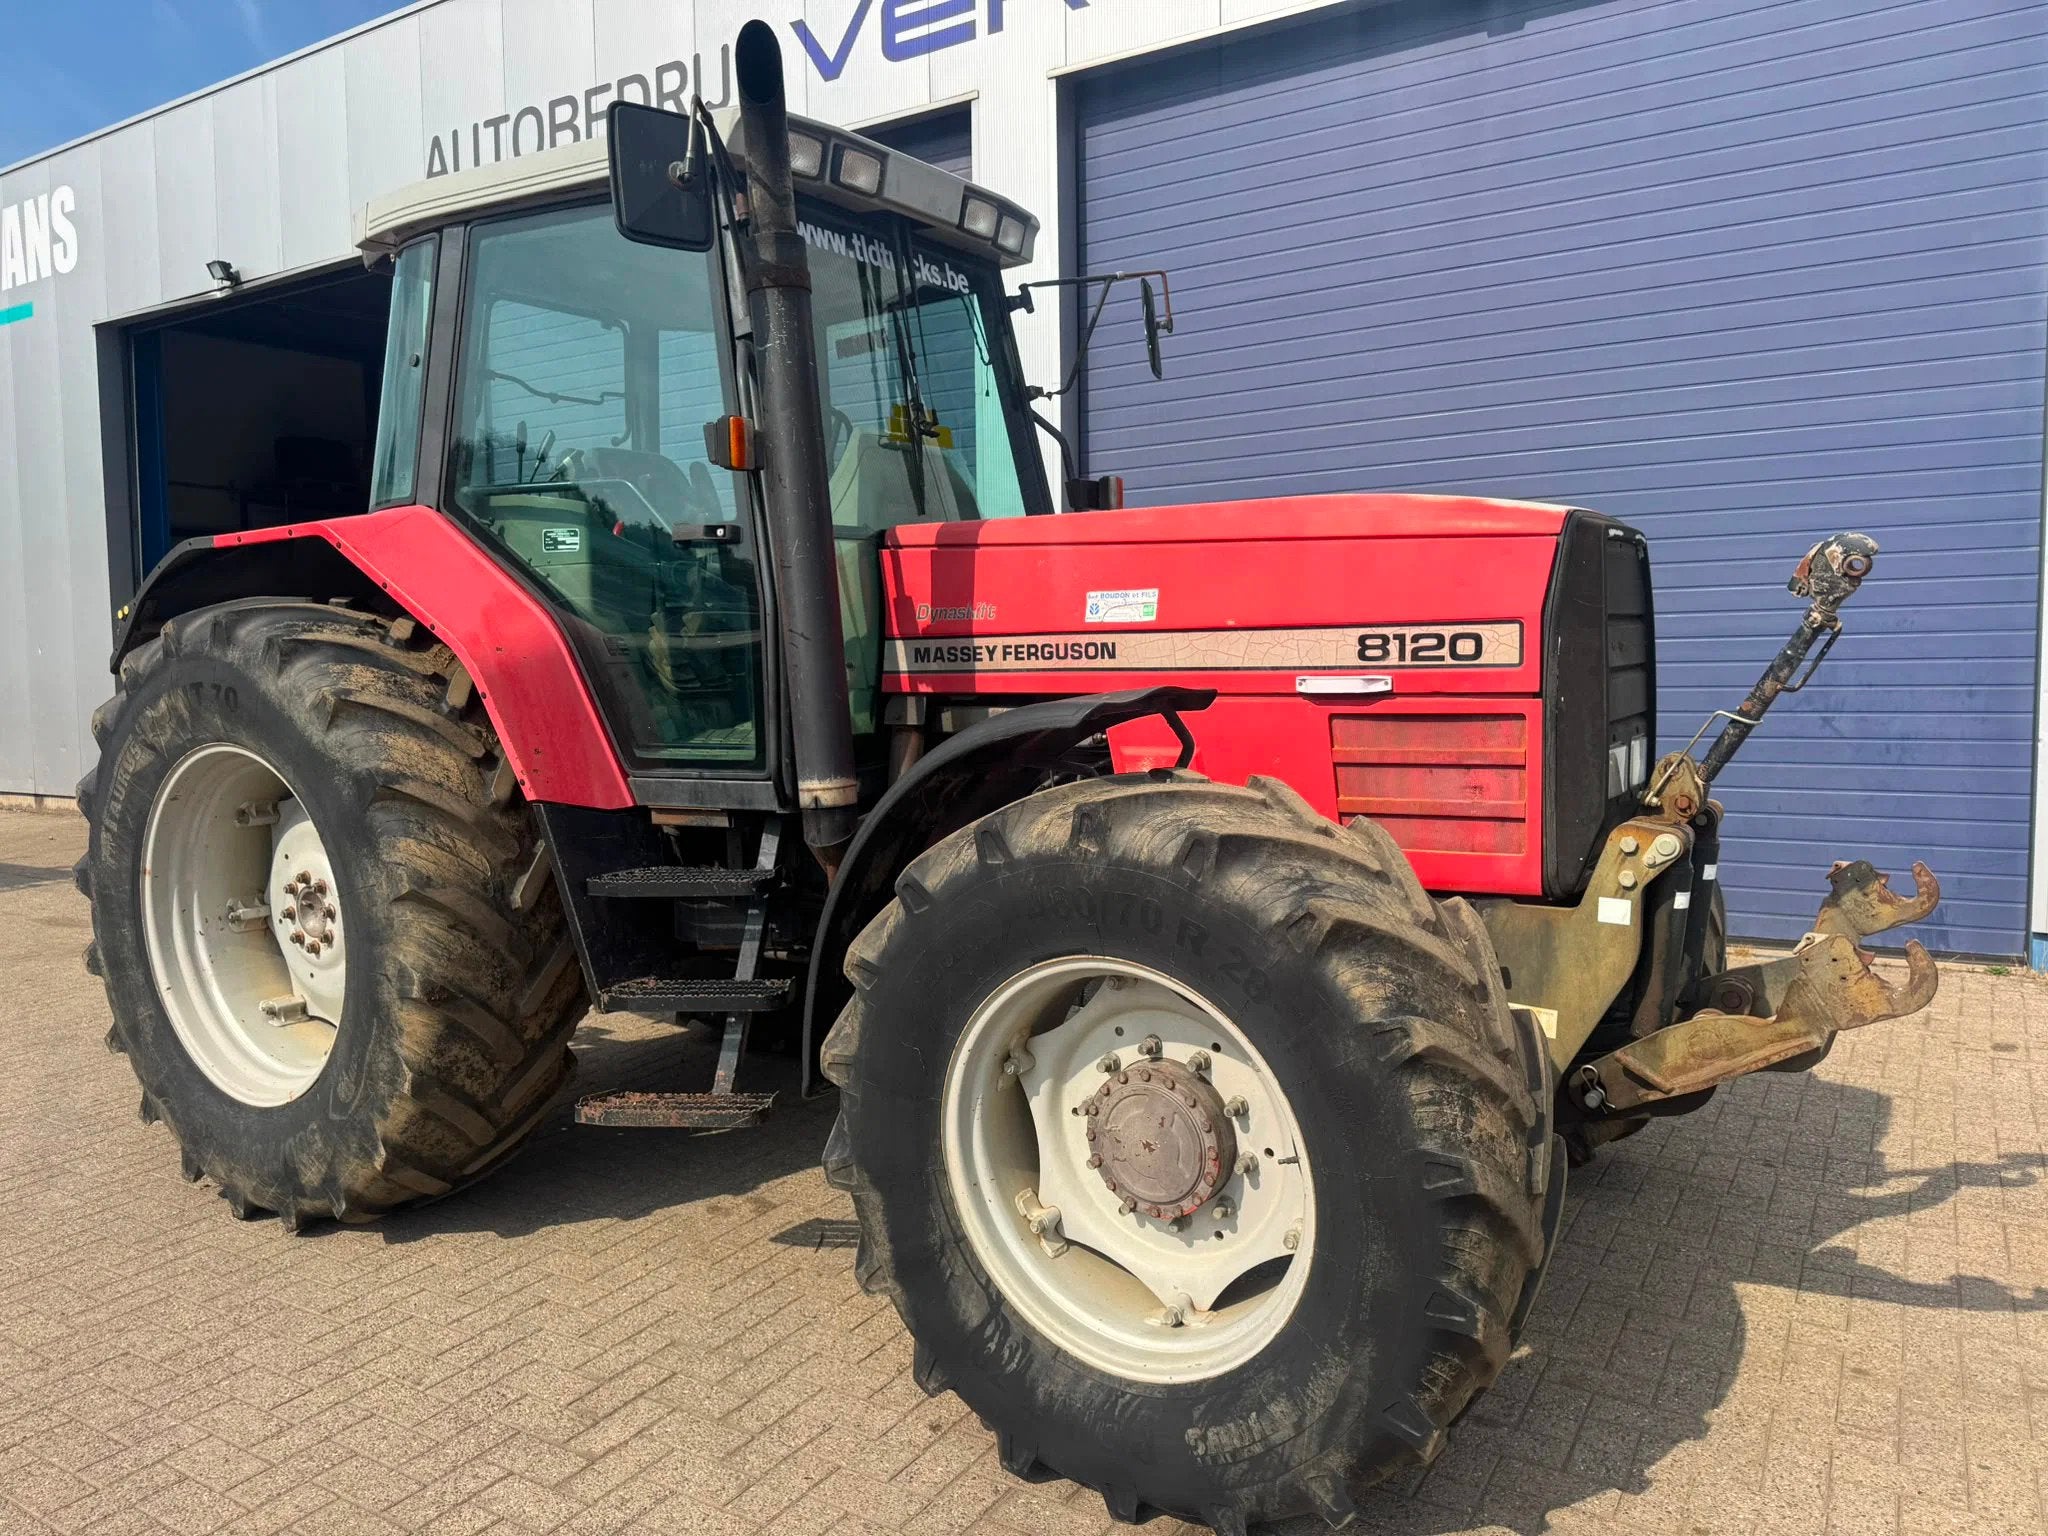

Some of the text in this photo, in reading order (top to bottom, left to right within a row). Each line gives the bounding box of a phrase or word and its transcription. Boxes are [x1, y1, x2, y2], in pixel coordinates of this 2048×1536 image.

[426, 43, 731, 180] AUTOBEDRIJ
[916, 602, 997, 624] Dynashift
[914, 641, 1117, 663] MASSEY FERGUSON
[1357, 632, 1483, 662] 8120
